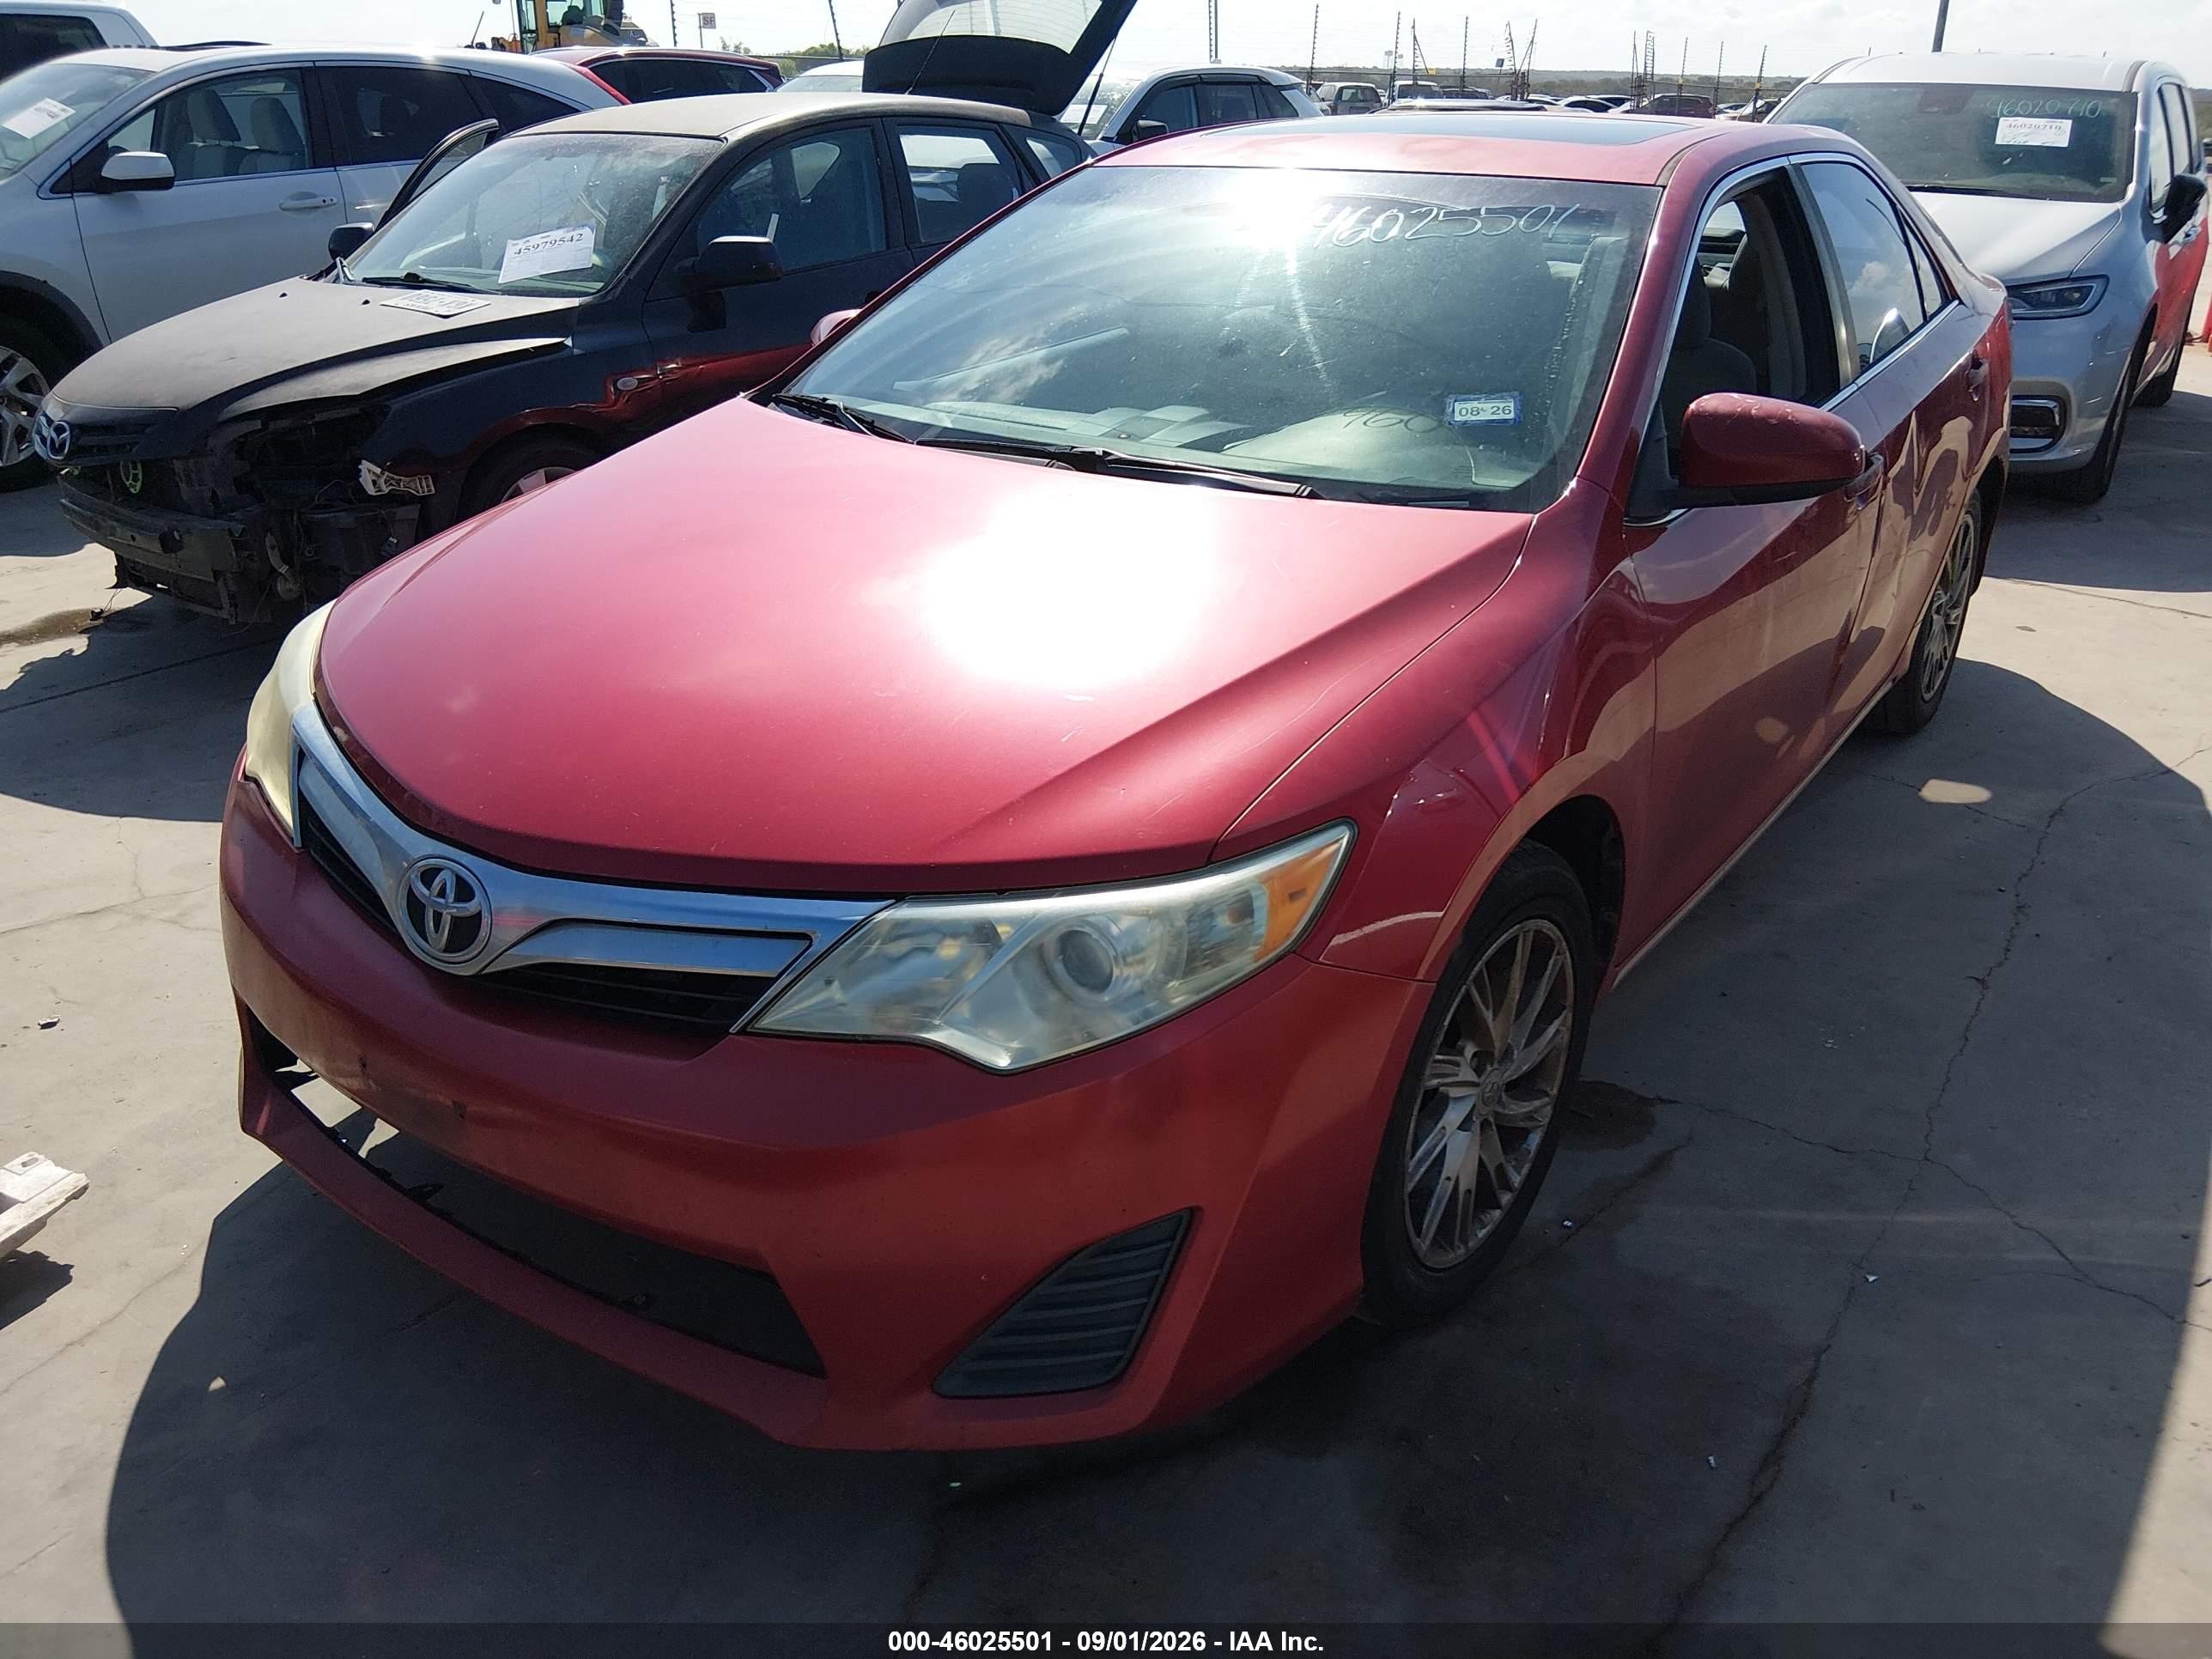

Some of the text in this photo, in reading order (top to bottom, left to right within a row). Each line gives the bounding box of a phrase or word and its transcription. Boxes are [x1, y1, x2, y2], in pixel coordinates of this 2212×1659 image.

[514, 233, 584, 255] 45979542
[1458, 404, 1512, 417] 08 26
